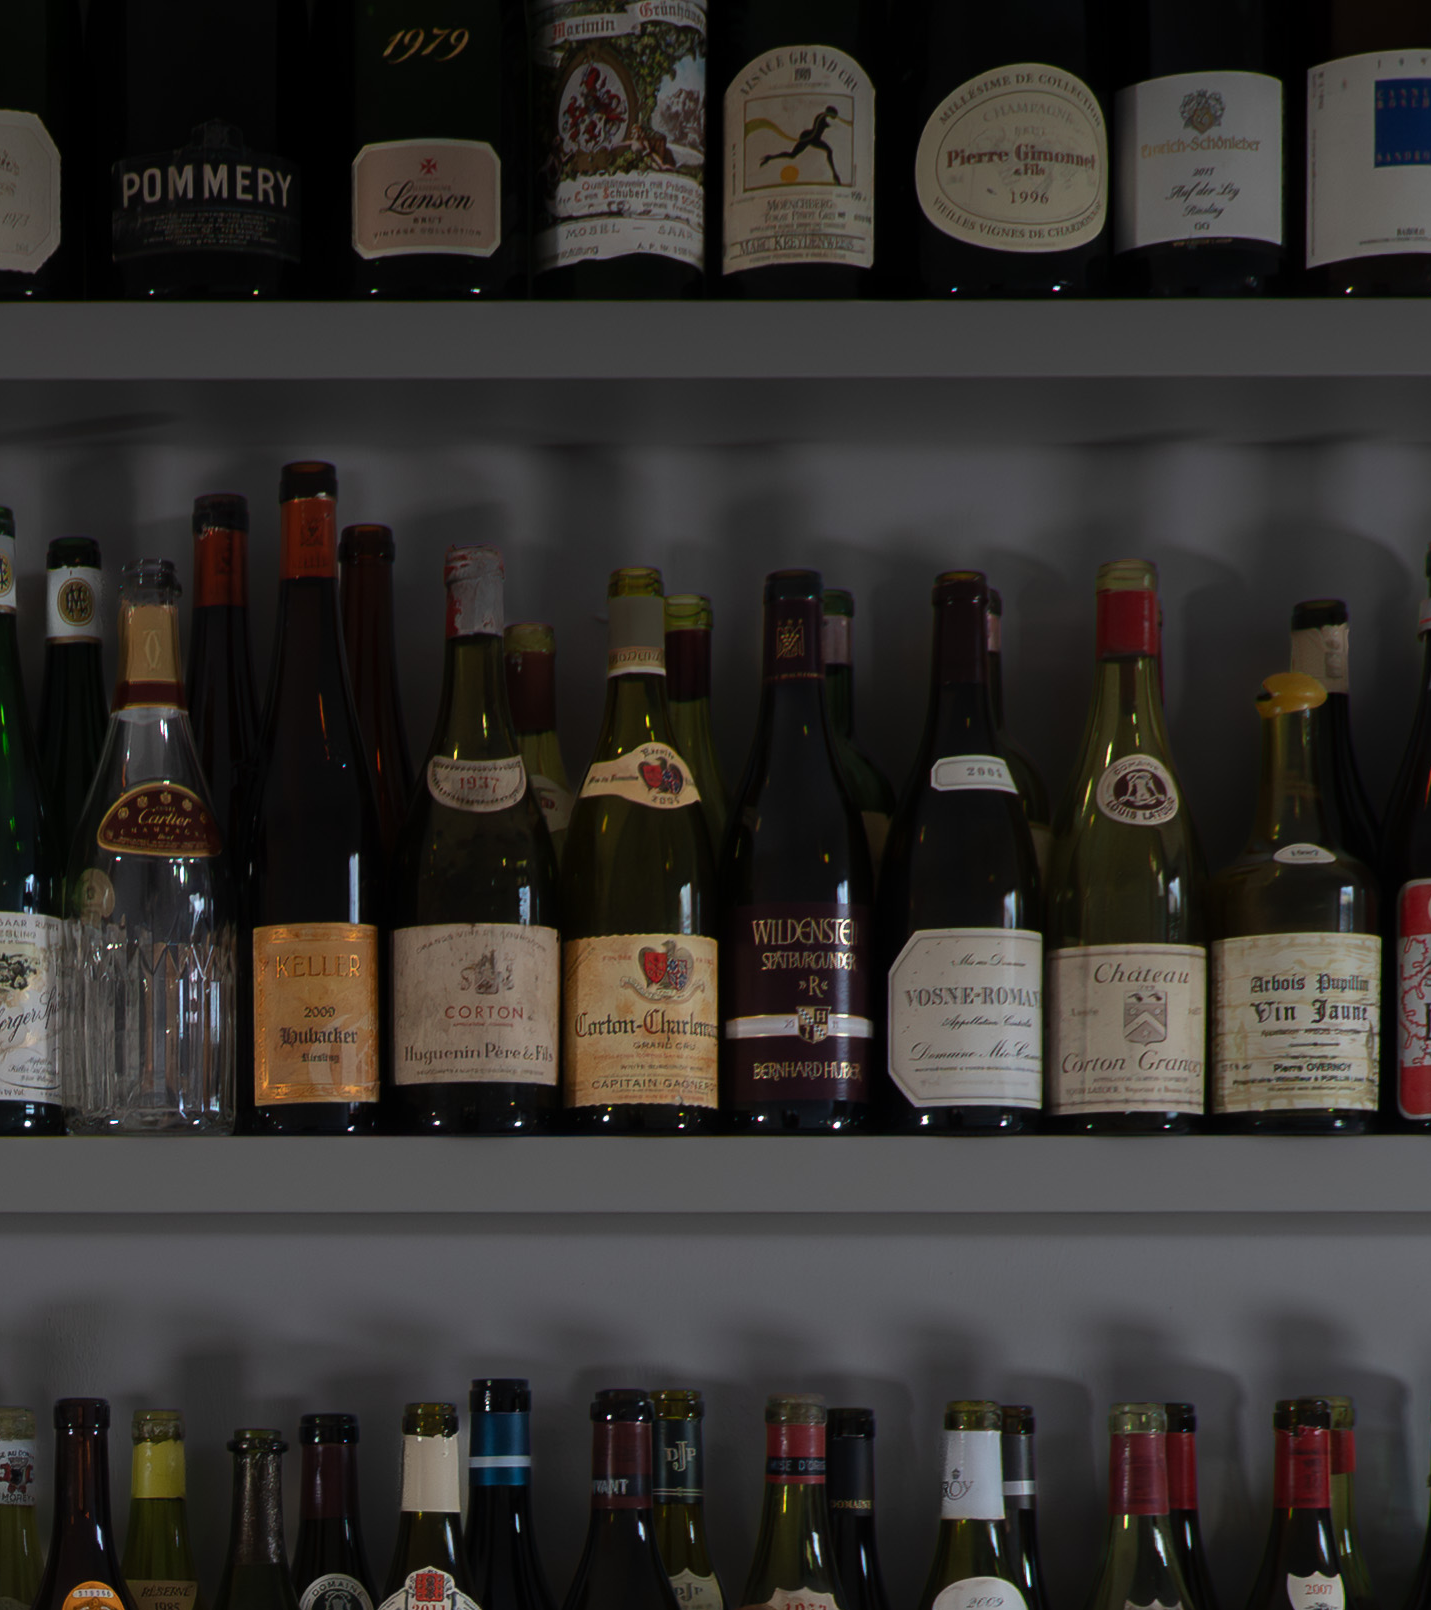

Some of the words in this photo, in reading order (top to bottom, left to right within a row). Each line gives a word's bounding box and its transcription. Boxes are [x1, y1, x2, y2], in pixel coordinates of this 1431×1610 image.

[379, 26, 470, 66] 1979
[946, 145, 1008, 169] Pierre
[121, 164, 291, 209] POMMERY
[383, 179, 476, 216] Lanson
[1009, 191, 1050, 206] 1996
[137, 808, 191, 831] Cartier
[275, 953, 362, 979] KELLER
[444, 1004, 525, 1020] CORTON
[752, 1059, 823, 1081] BERNHARD
[825, 1059, 862, 1082] HUBER
[1273, 1063, 1306, 1073] Pierre
[1305, 1583, 1333, 1597] 2007
